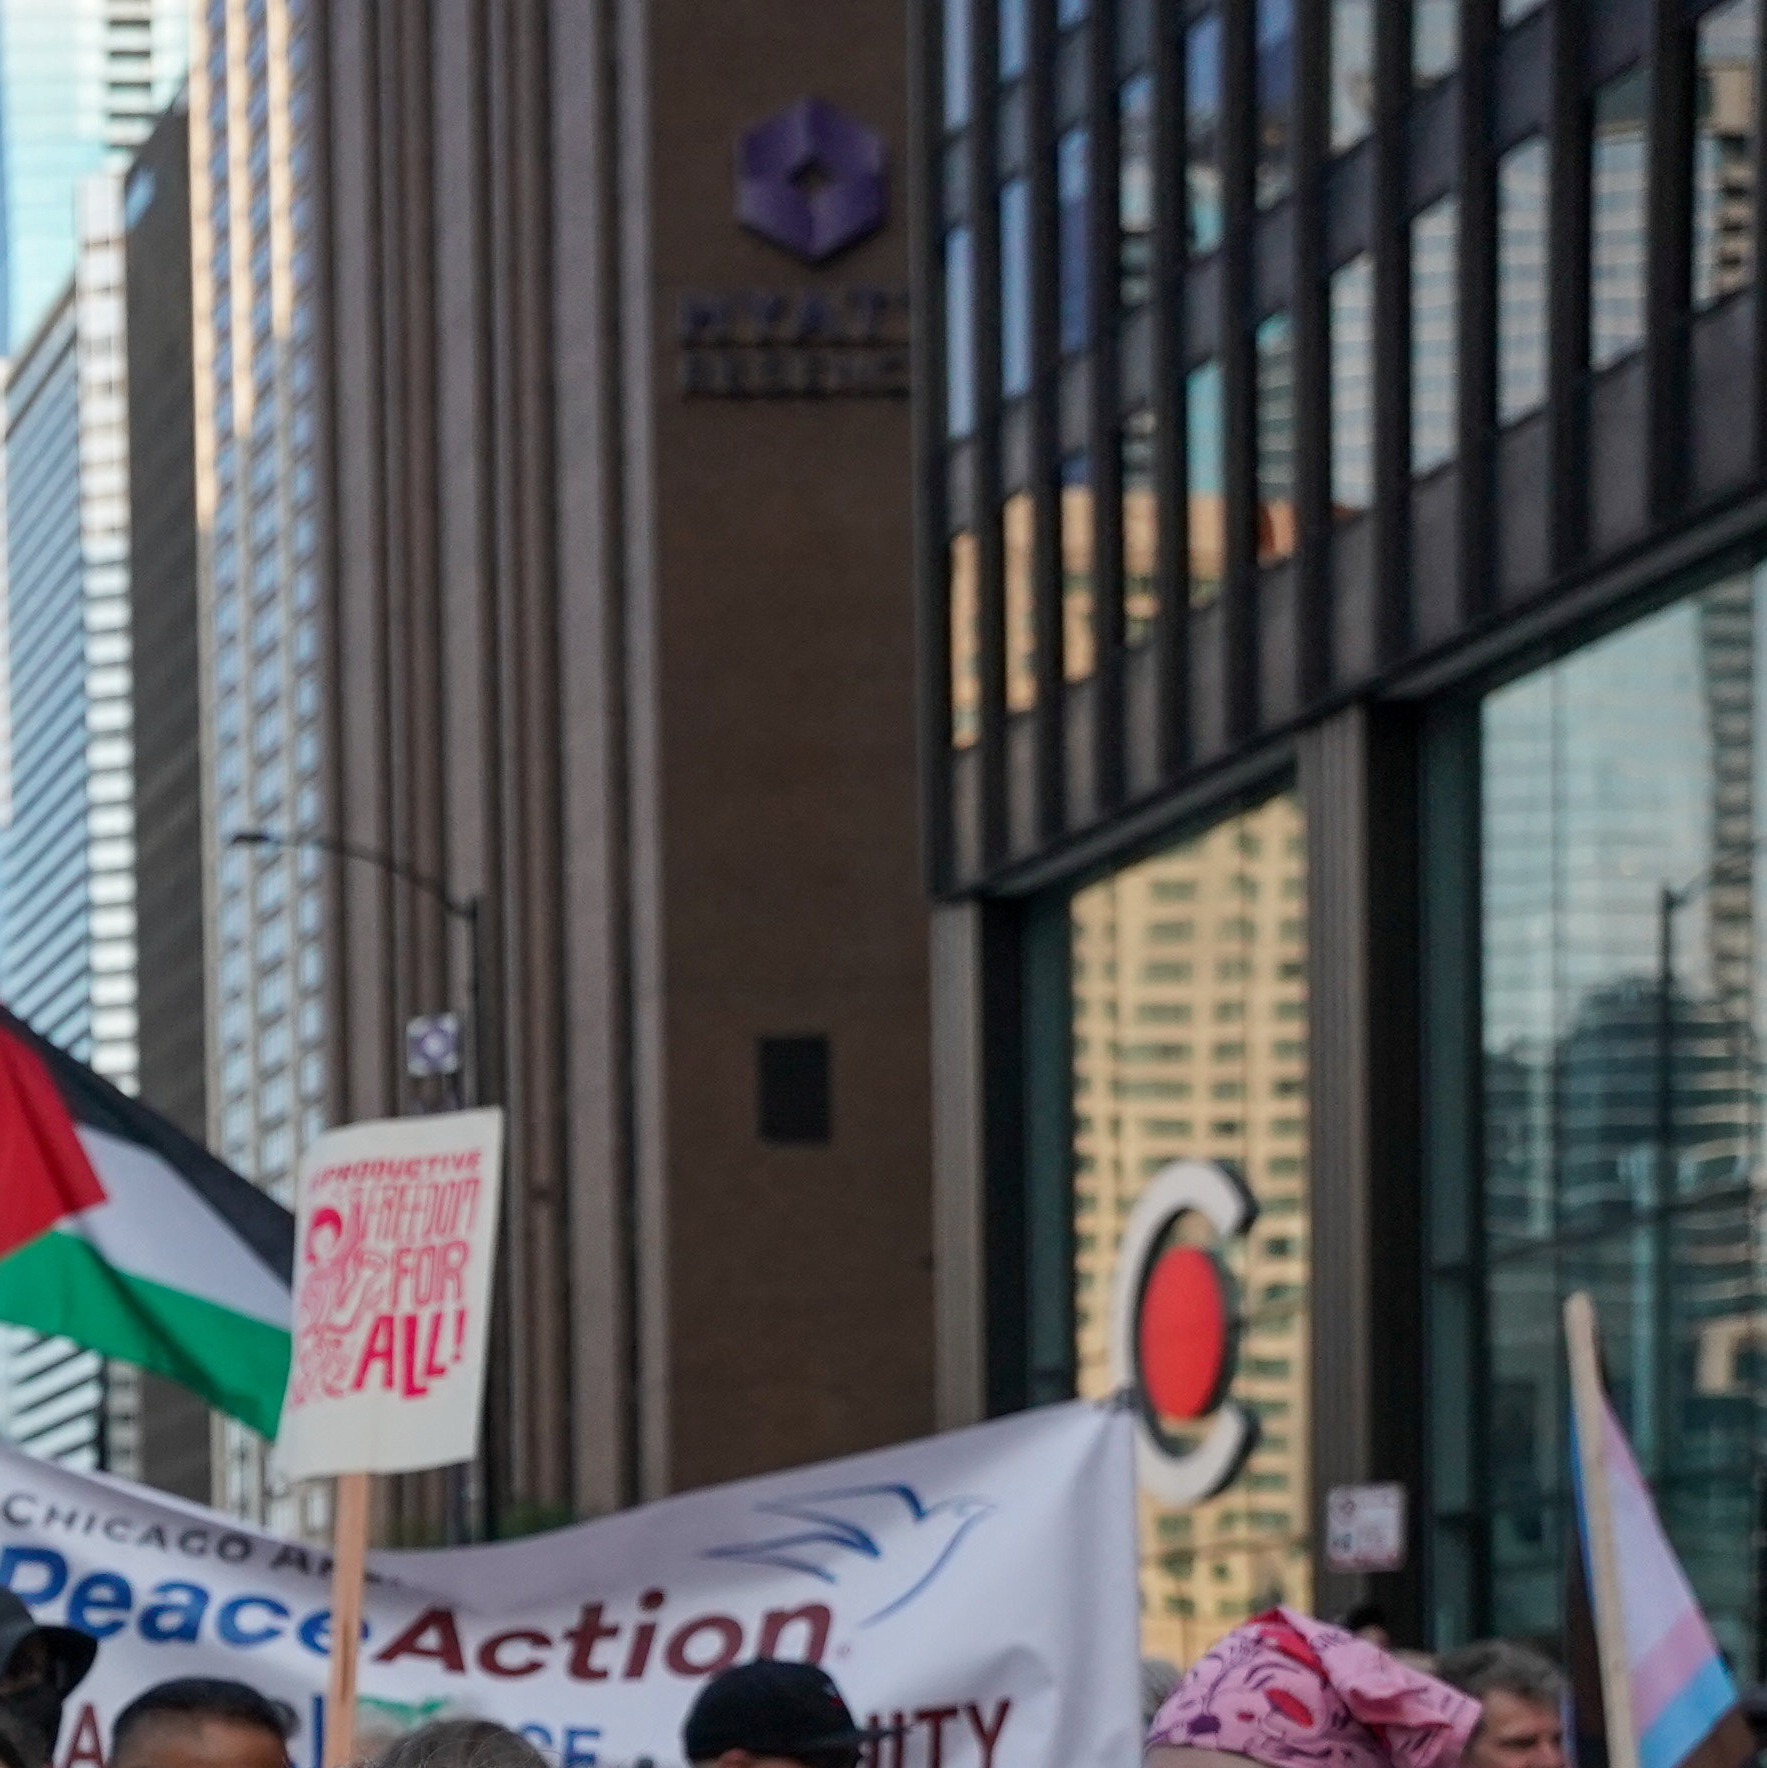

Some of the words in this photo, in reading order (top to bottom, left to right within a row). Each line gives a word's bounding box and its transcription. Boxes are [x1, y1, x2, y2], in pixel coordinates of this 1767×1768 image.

[353, 1308, 466, 1399] ALL!
[2, 1492, 252, 1564] CHICAGO
[378, 1588, 833, 1682] Action
